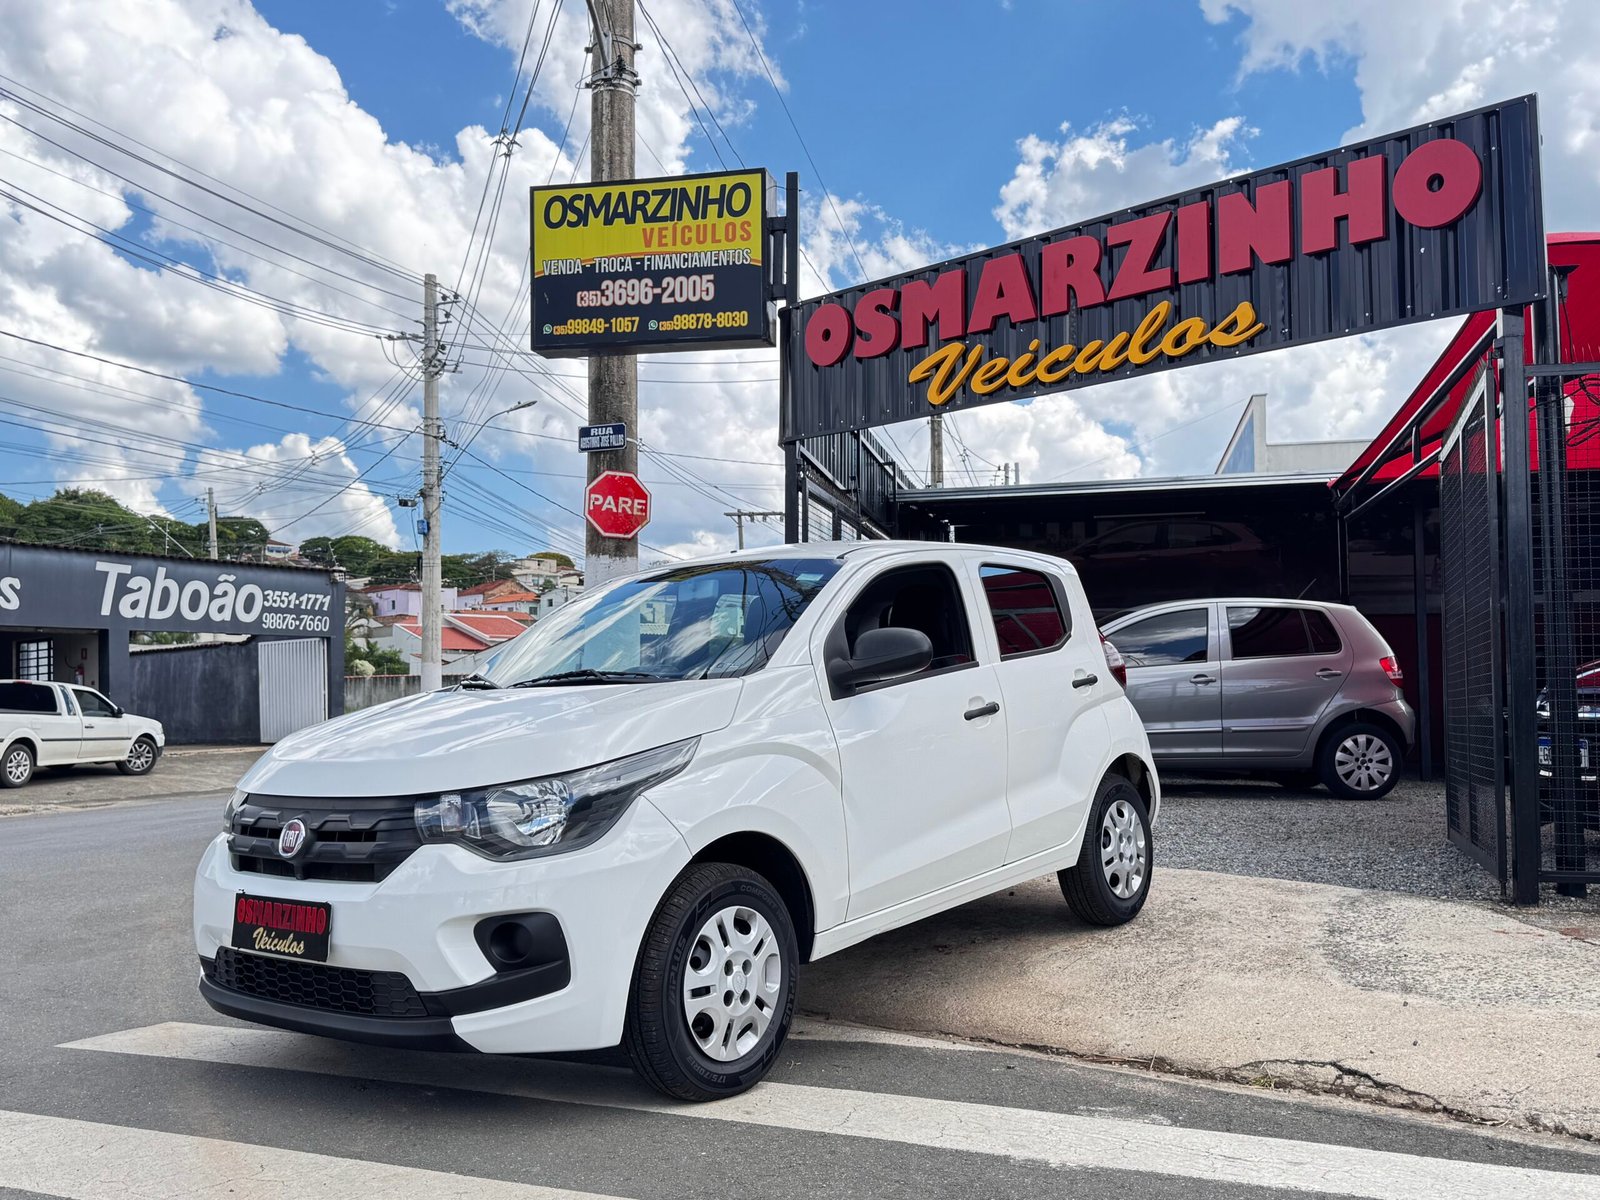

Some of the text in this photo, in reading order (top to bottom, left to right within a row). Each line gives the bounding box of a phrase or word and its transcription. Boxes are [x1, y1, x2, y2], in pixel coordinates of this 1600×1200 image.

[543, 181, 751, 229] OSMARZINHO
[642, 220, 752, 248] VEÍCULOS
[543, 259, 583, 276] VENDA
[593, 256, 633, 273] TROCA
[643, 248, 751, 271] FINANCIAMENTOS
[804, 139, 1482, 367] OSMARZINHO
[909, 300, 1265, 405] Veiculos
[590, 426, 614, 436] RUA
[590, 493, 646, 516] PARE
[95, 561, 264, 623] Taboão
[282, 830, 300, 848] FIAT
[237, 898, 327, 935] OSMARZINHO
[252, 927, 305, 955] Veiculos
